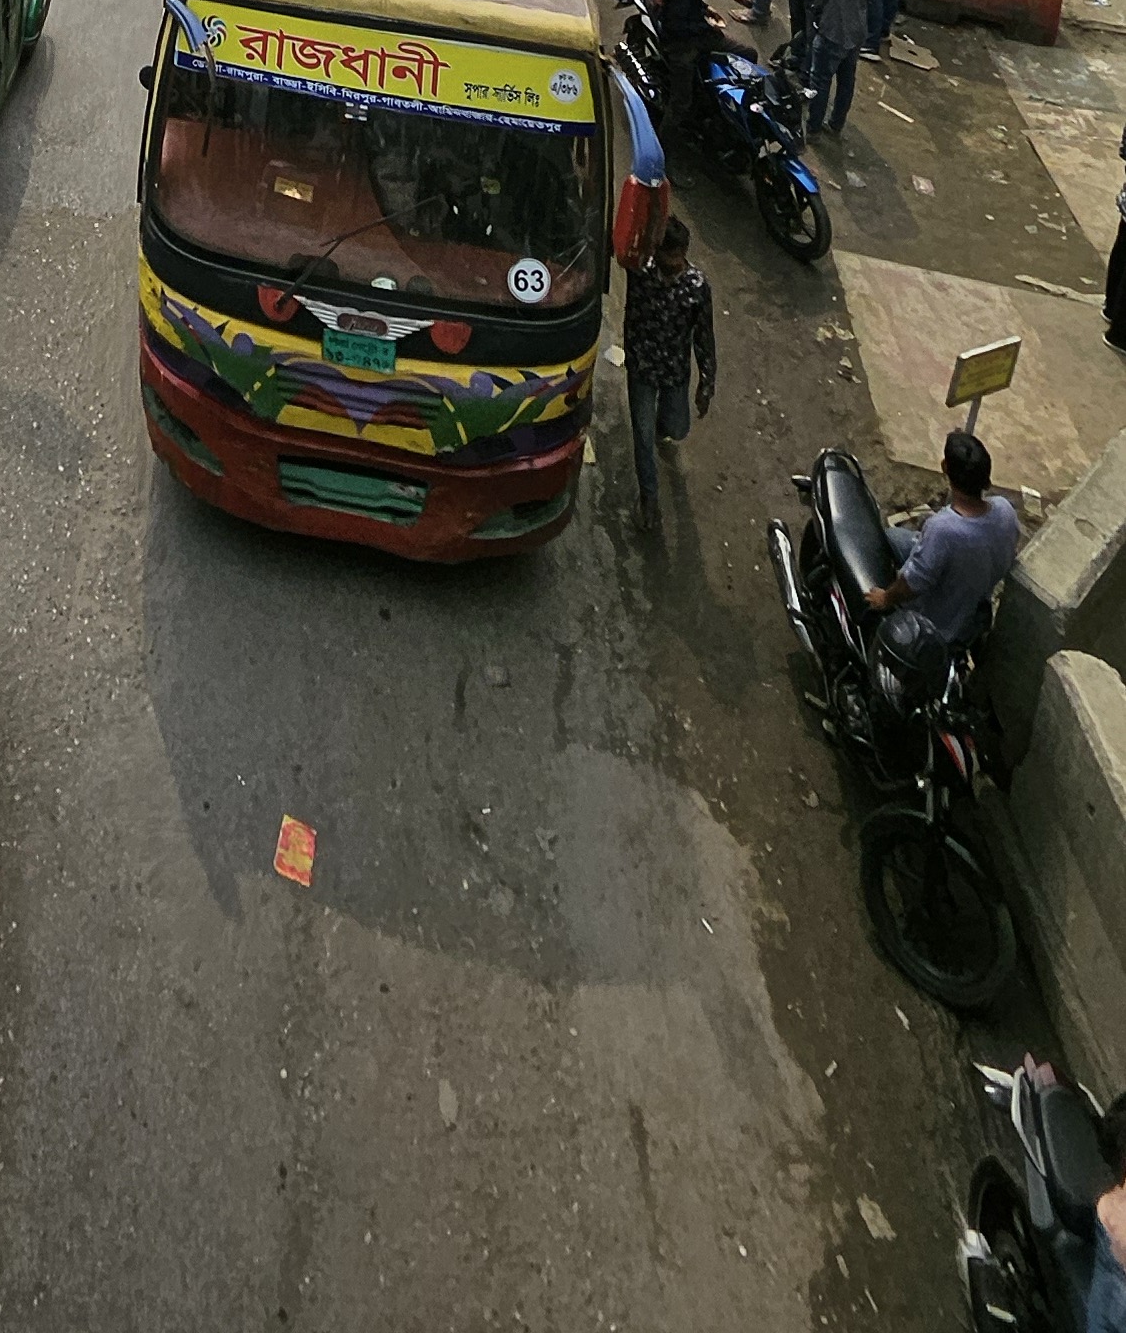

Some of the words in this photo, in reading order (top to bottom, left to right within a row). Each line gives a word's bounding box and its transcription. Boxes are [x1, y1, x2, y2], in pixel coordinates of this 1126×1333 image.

[235, 23, 451, 98] রাজধানী
[463, 81, 490, 102] সুপার
[514, 269, 544, 292] 63
